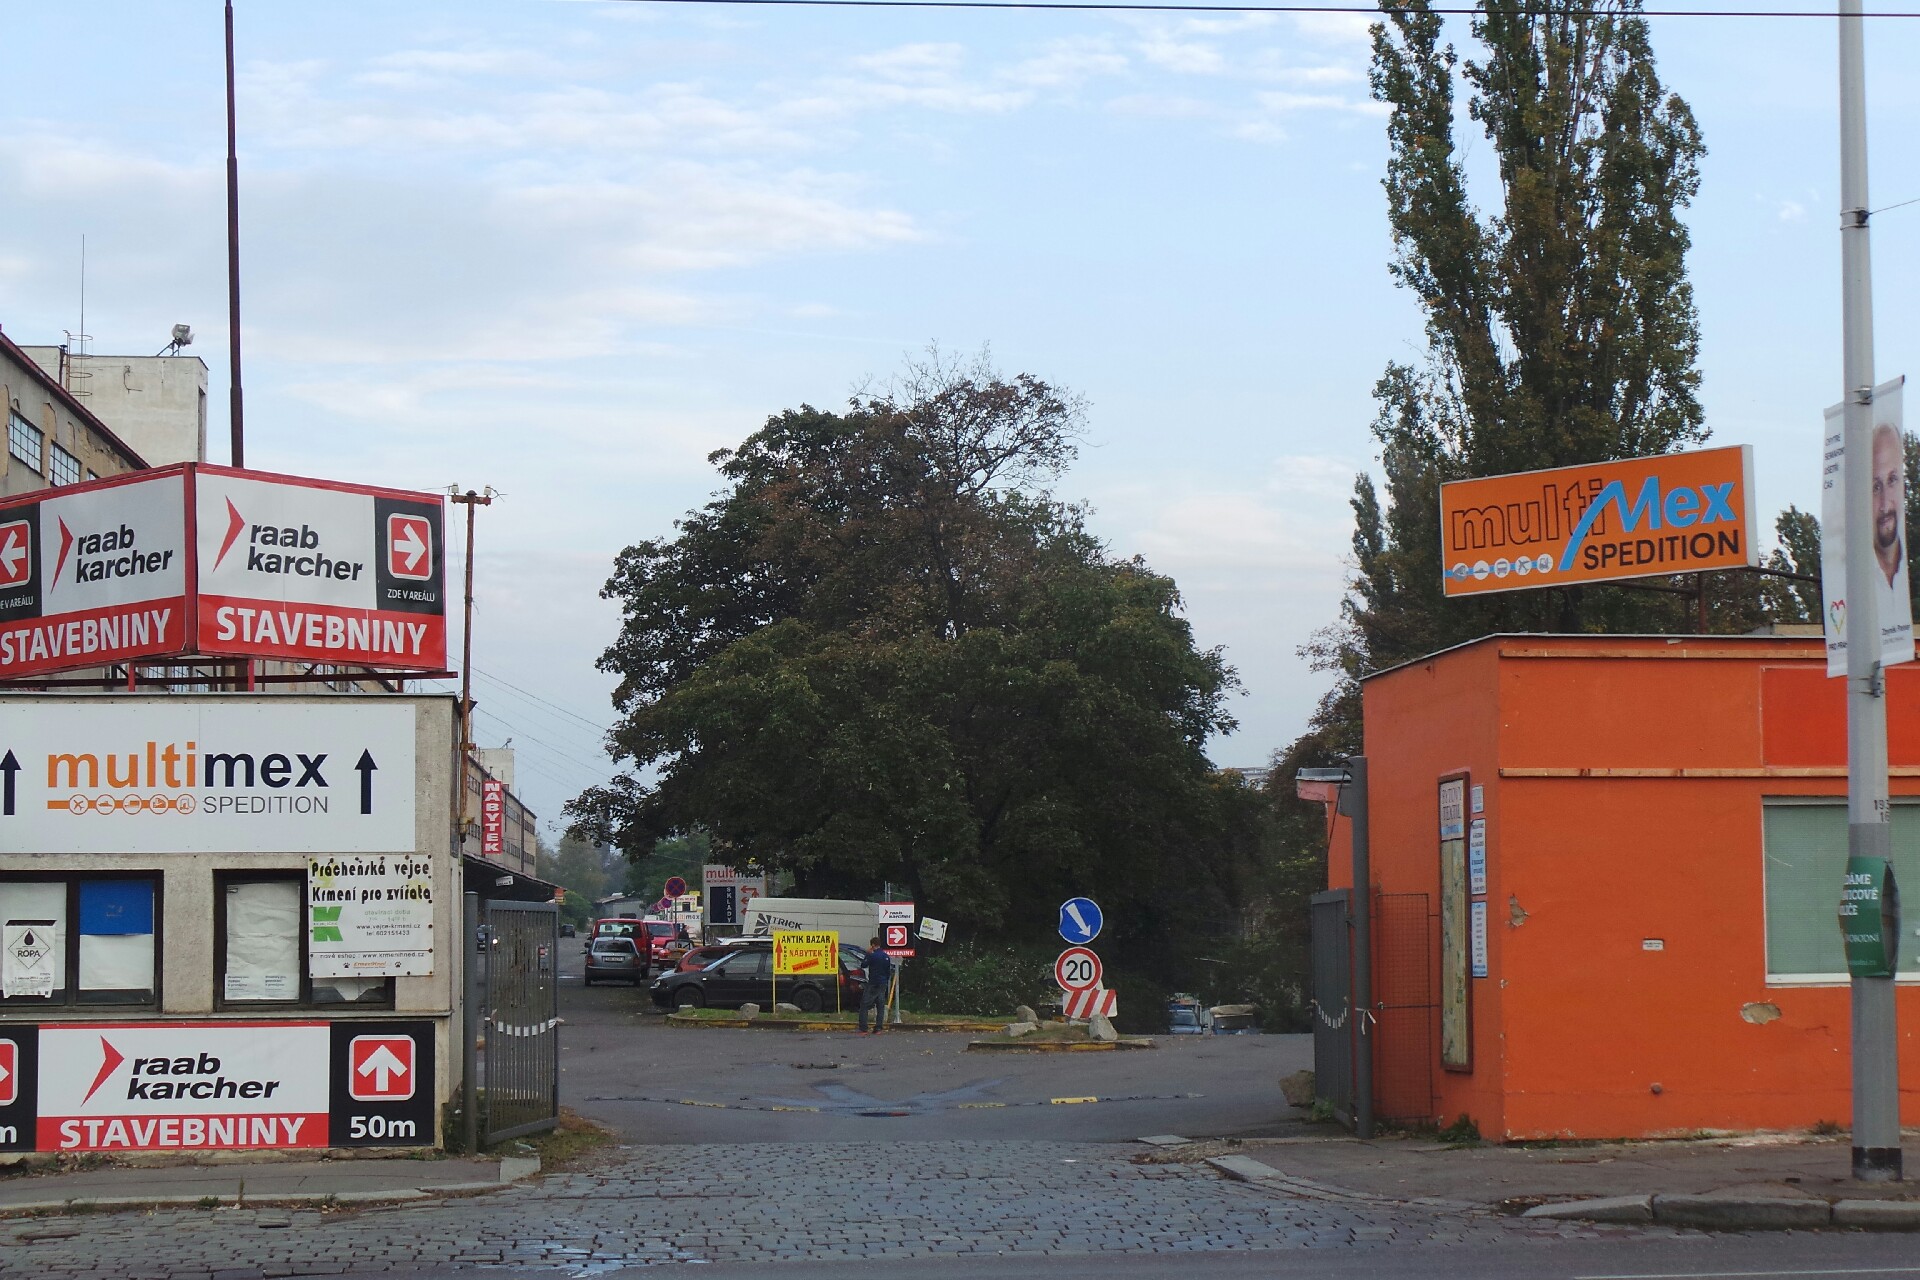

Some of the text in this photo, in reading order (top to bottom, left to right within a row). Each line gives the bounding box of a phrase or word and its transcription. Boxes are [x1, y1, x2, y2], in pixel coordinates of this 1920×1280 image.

[78, 524, 135, 555] raab
[250, 523, 319, 550] raab
[1583, 530, 1738, 570] SPEDITION
[76, 548, 173, 584] karcher
[247, 546, 364, 581] karcher
[10, 594, 34, 608] AREÁLU
[387, 588, 435, 602] ZDE V AREÁLU
[0, 608, 172, 665] STAVEBNINY
[216, 606, 428, 656] STAVEBNINY
[48, 741, 329, 788] multimex
[203, 796, 329, 814] SPEDITION
[312, 860, 430, 879] Prácheňská vejce
[312, 885, 431, 904] Krmení pro zvířata
[1066, 960, 1092, 981] 20
[133, 1052, 220, 1075] raab
[127, 1076, 280, 1100] karcher
[59, 1117, 306, 1148] STAVEBNINY
[350, 1115, 416, 1138] 50m
